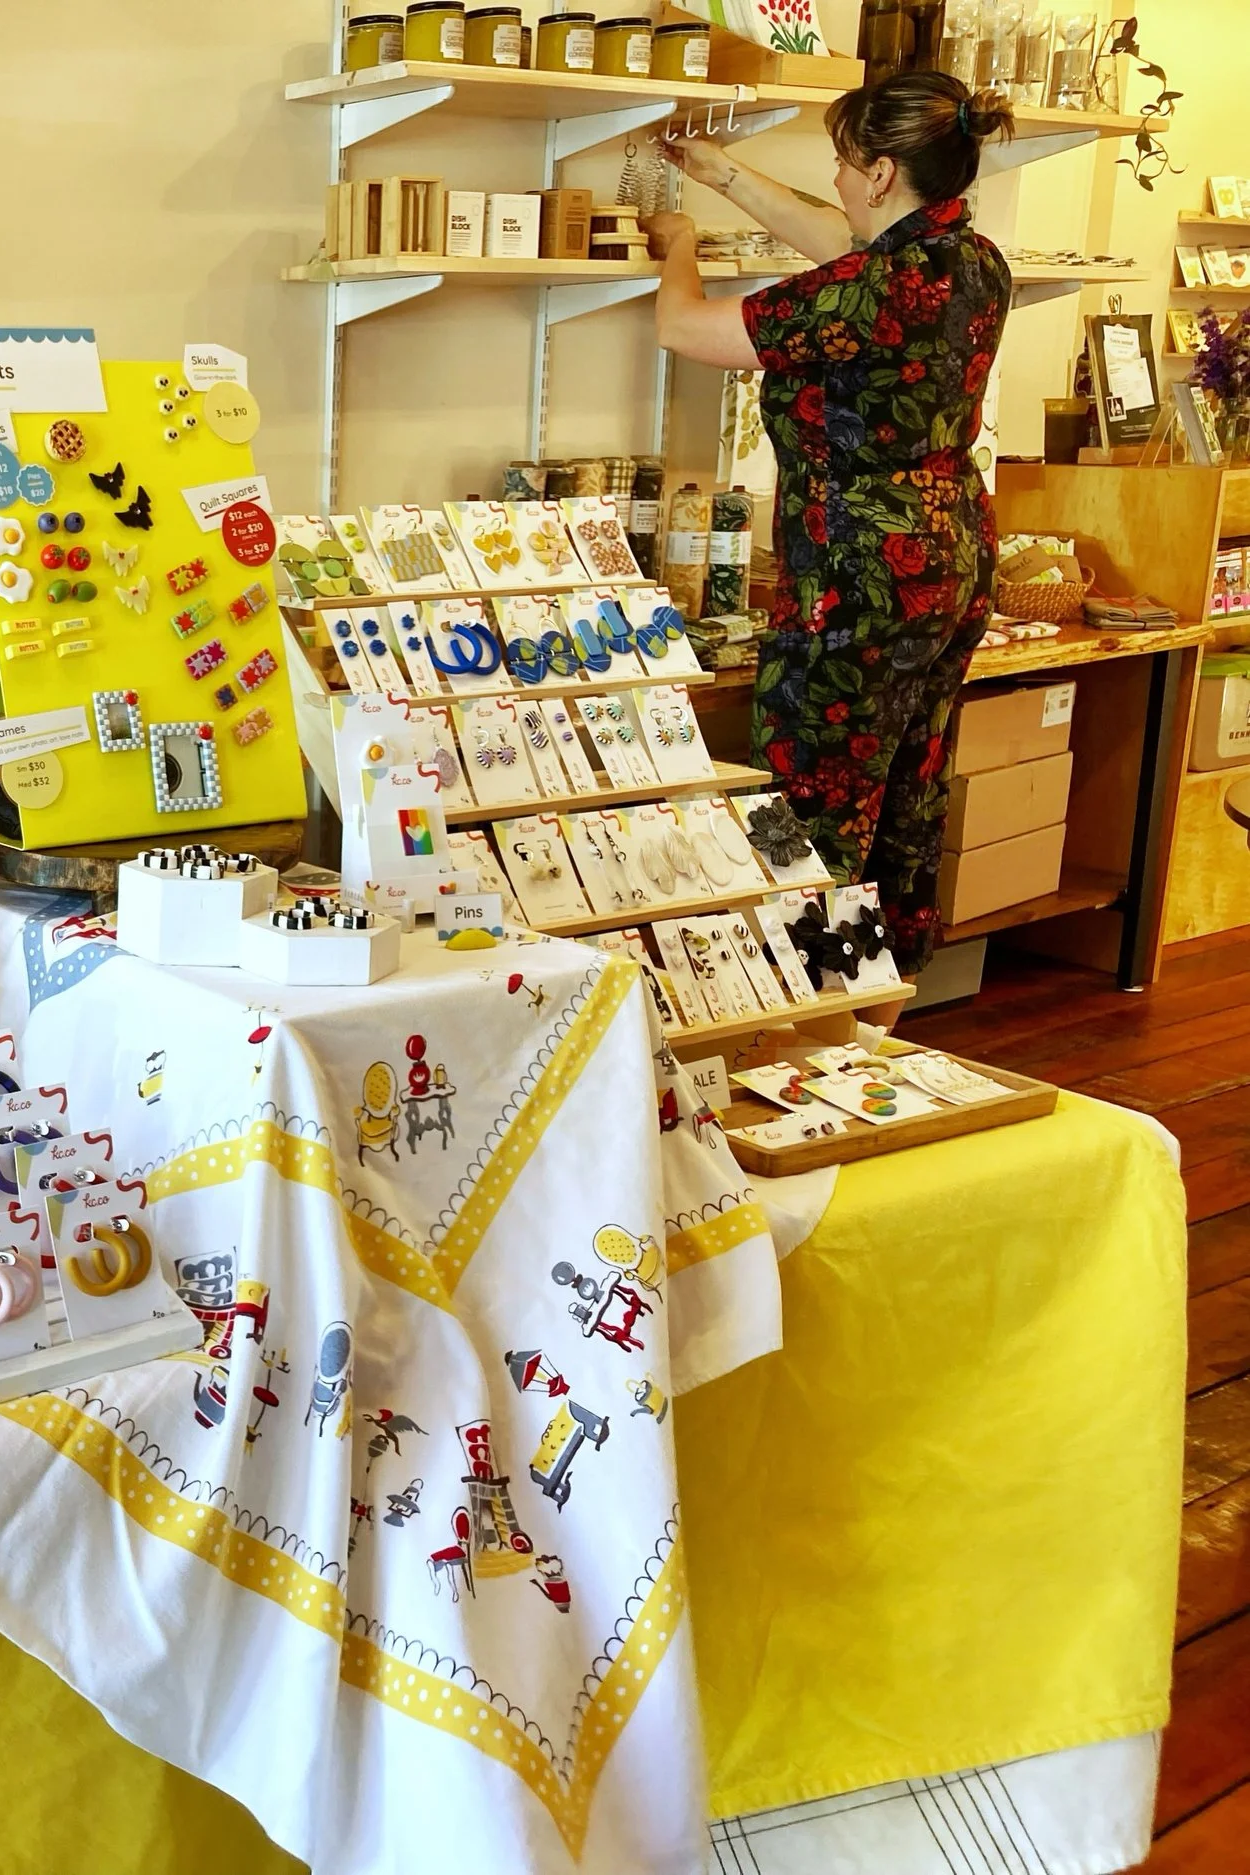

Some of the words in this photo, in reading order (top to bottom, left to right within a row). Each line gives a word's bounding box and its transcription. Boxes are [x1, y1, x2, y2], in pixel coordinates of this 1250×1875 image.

[191, 356, 218, 366] Skulls
[216, 409, 222, 417] 3
[233, 408, 247, 417] $10
[31, 489, 44, 497] $20
[200, 497, 220, 512] Quilt
[222, 484, 258, 503] Squares
[229, 511, 243, 521] $12
[231, 528, 237, 536] 2
[247, 523, 263, 533] $20
[238, 548, 244, 556] 3
[254, 543, 269, 553] $28
[19, 644, 39, 652] BUTTER
[29, 761, 46, 772] $30
[33, 777, 50, 787] $32
[455, 906, 483, 919] Pins
[694, 1070, 717, 1088] ALE
[153, 1310, 165, 1318] $20
